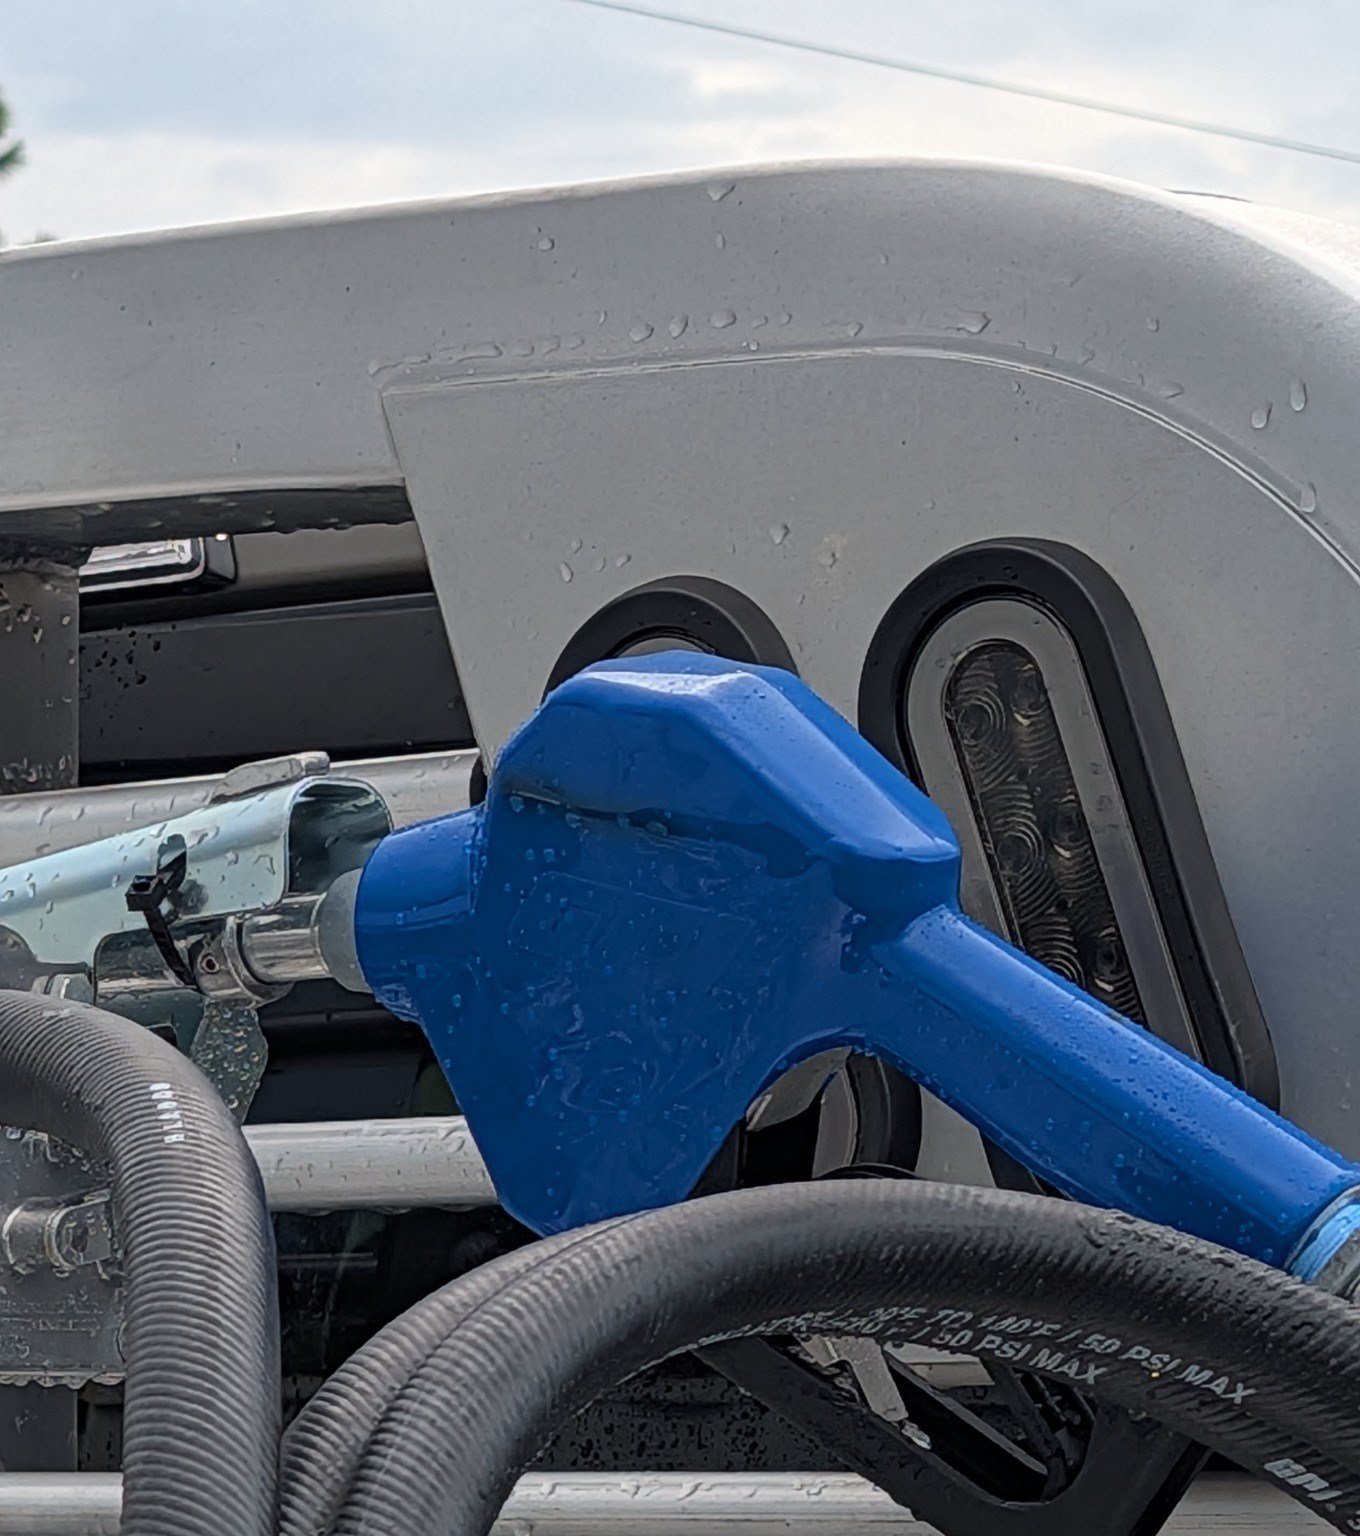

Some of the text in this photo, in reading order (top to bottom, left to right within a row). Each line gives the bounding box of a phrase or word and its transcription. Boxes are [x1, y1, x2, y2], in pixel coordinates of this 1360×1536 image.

[974, 1335, 1033, 1362] PSI
[1029, 1347, 1108, 1385] MAX
[1078, 1333, 1122, 1354] 50
[1118, 1345, 1182, 1374] PSI
[1174, 1364, 1257, 1405] MAX
